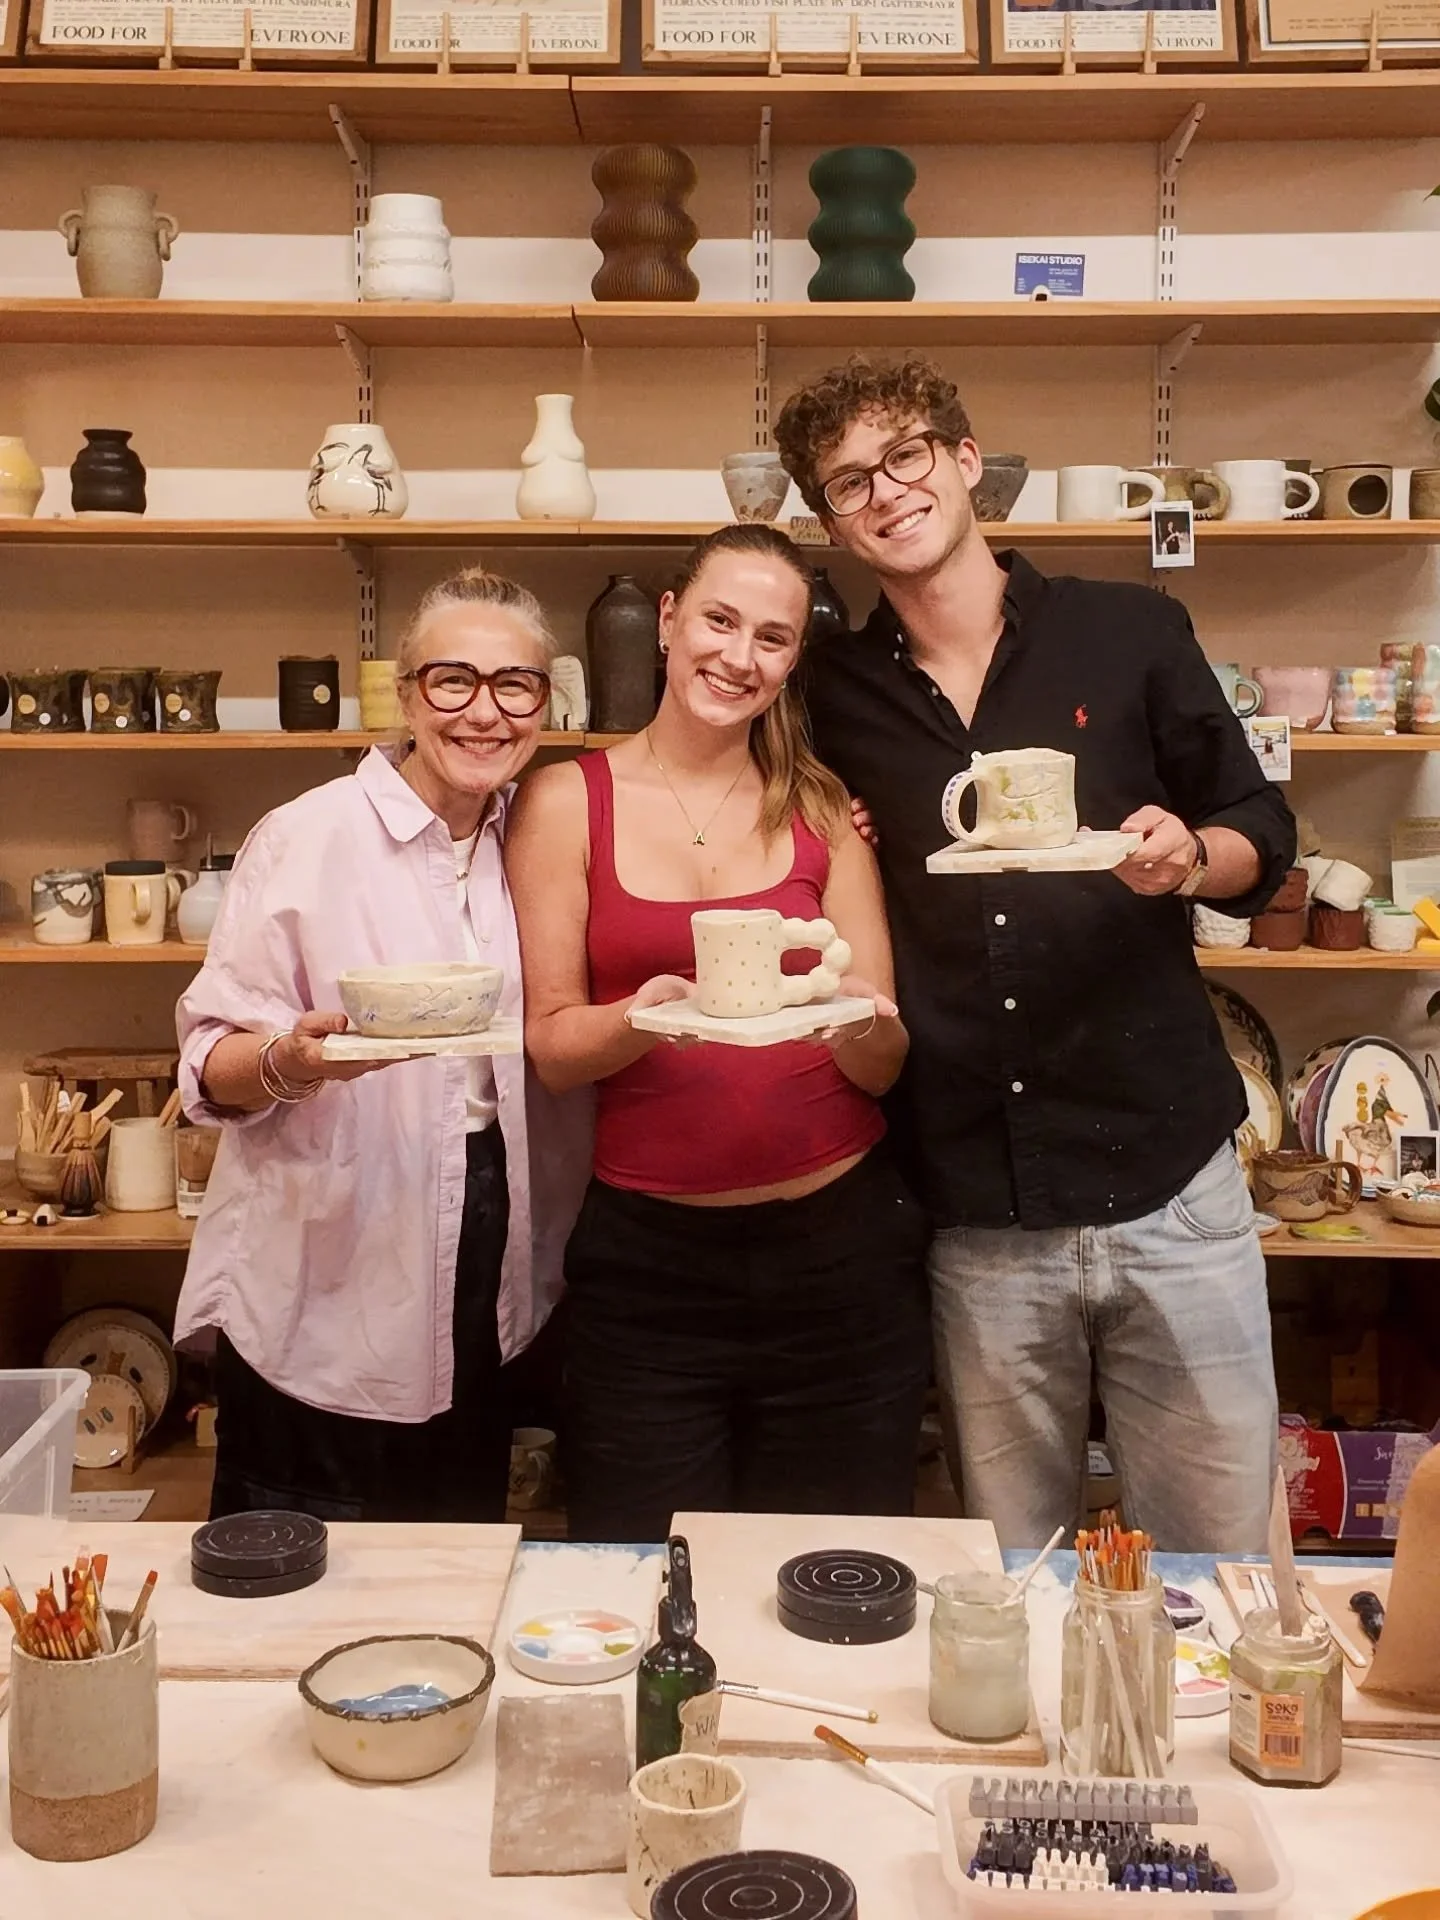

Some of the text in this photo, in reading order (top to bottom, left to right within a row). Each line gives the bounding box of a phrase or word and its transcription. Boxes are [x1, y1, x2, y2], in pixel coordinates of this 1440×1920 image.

[52, 25, 351, 45] FOOD FOR EVERYONE
[662, 30, 957, 46] FOOD FOR EVERYONE
[394, 38, 432, 49] FOOD
[531, 38, 602, 49] EVERYONE
[1008, 38, 1045, 49] FOOD
[1153, 37, 1217, 48] VERYONE
[1049, 255, 1083, 265] STUDIO
